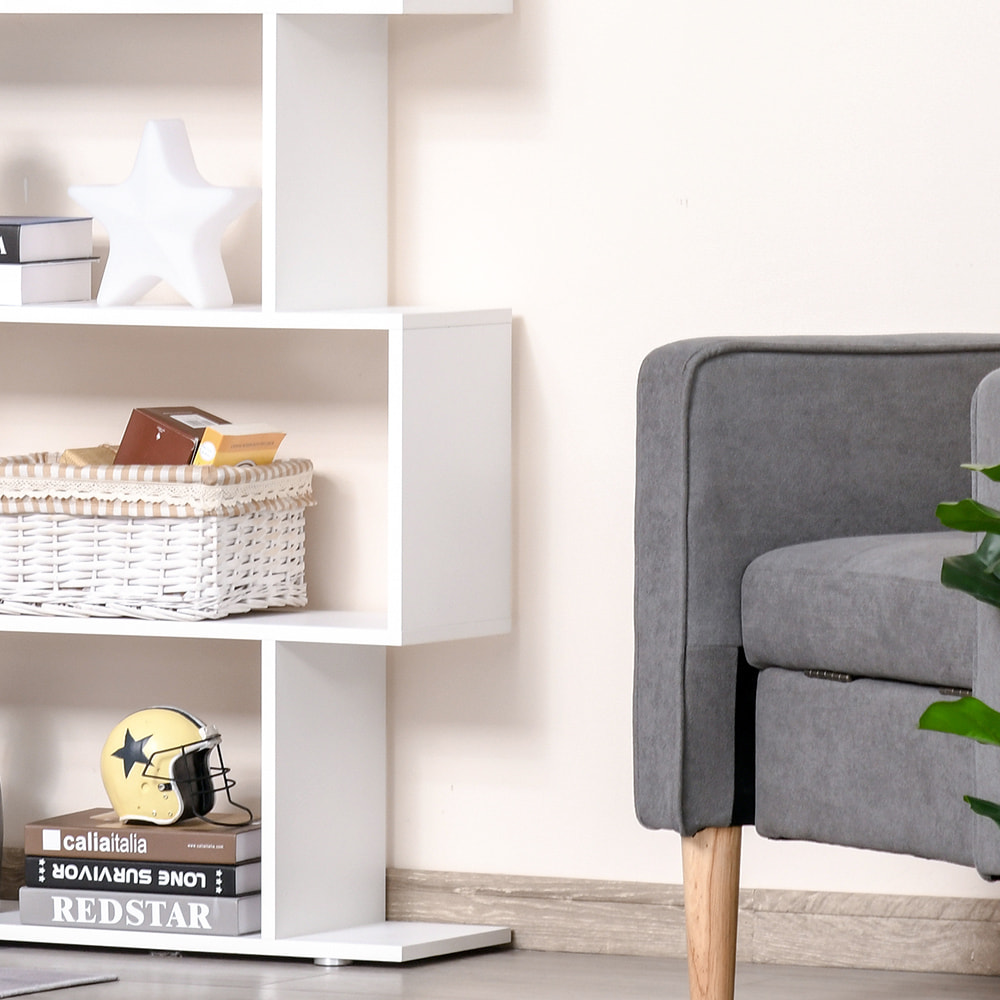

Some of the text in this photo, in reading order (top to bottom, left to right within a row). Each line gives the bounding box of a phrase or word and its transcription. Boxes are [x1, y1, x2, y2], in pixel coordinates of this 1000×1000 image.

[63, 832, 147, 854] caliaitalia
[52, 863, 206, 888] LONE SURVIVOR
